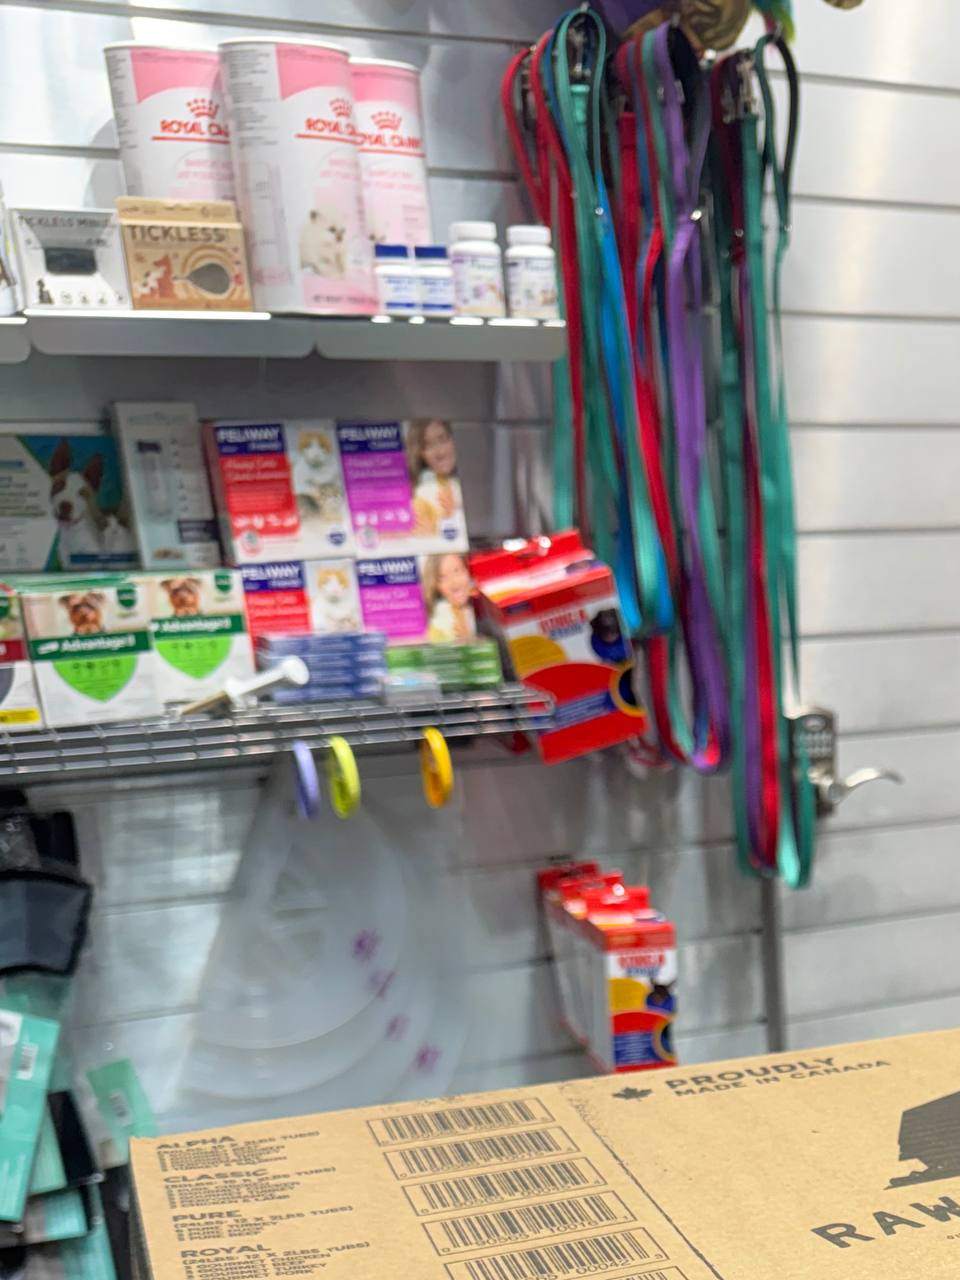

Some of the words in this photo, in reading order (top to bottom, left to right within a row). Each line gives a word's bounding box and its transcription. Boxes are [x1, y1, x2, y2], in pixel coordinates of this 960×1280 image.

[128, 224, 226, 243] TICKLESS
[217, 426, 281, 443] FELIWAY
[339, 424, 400, 442] FELIWAY
[242, 562, 301, 580] FELIWAY
[358, 559, 416, 577] FELIWAY
[665, 1057, 836, 1089] PROUDLY
[673, 1081, 747, 1097] MADE
[789, 1060, 891, 1080] CANADA
[164, 1168, 268, 1183] CLASSIC
[173, 1210, 240, 1222] PURE
[181, 1243, 270, 1257] ROYAL
